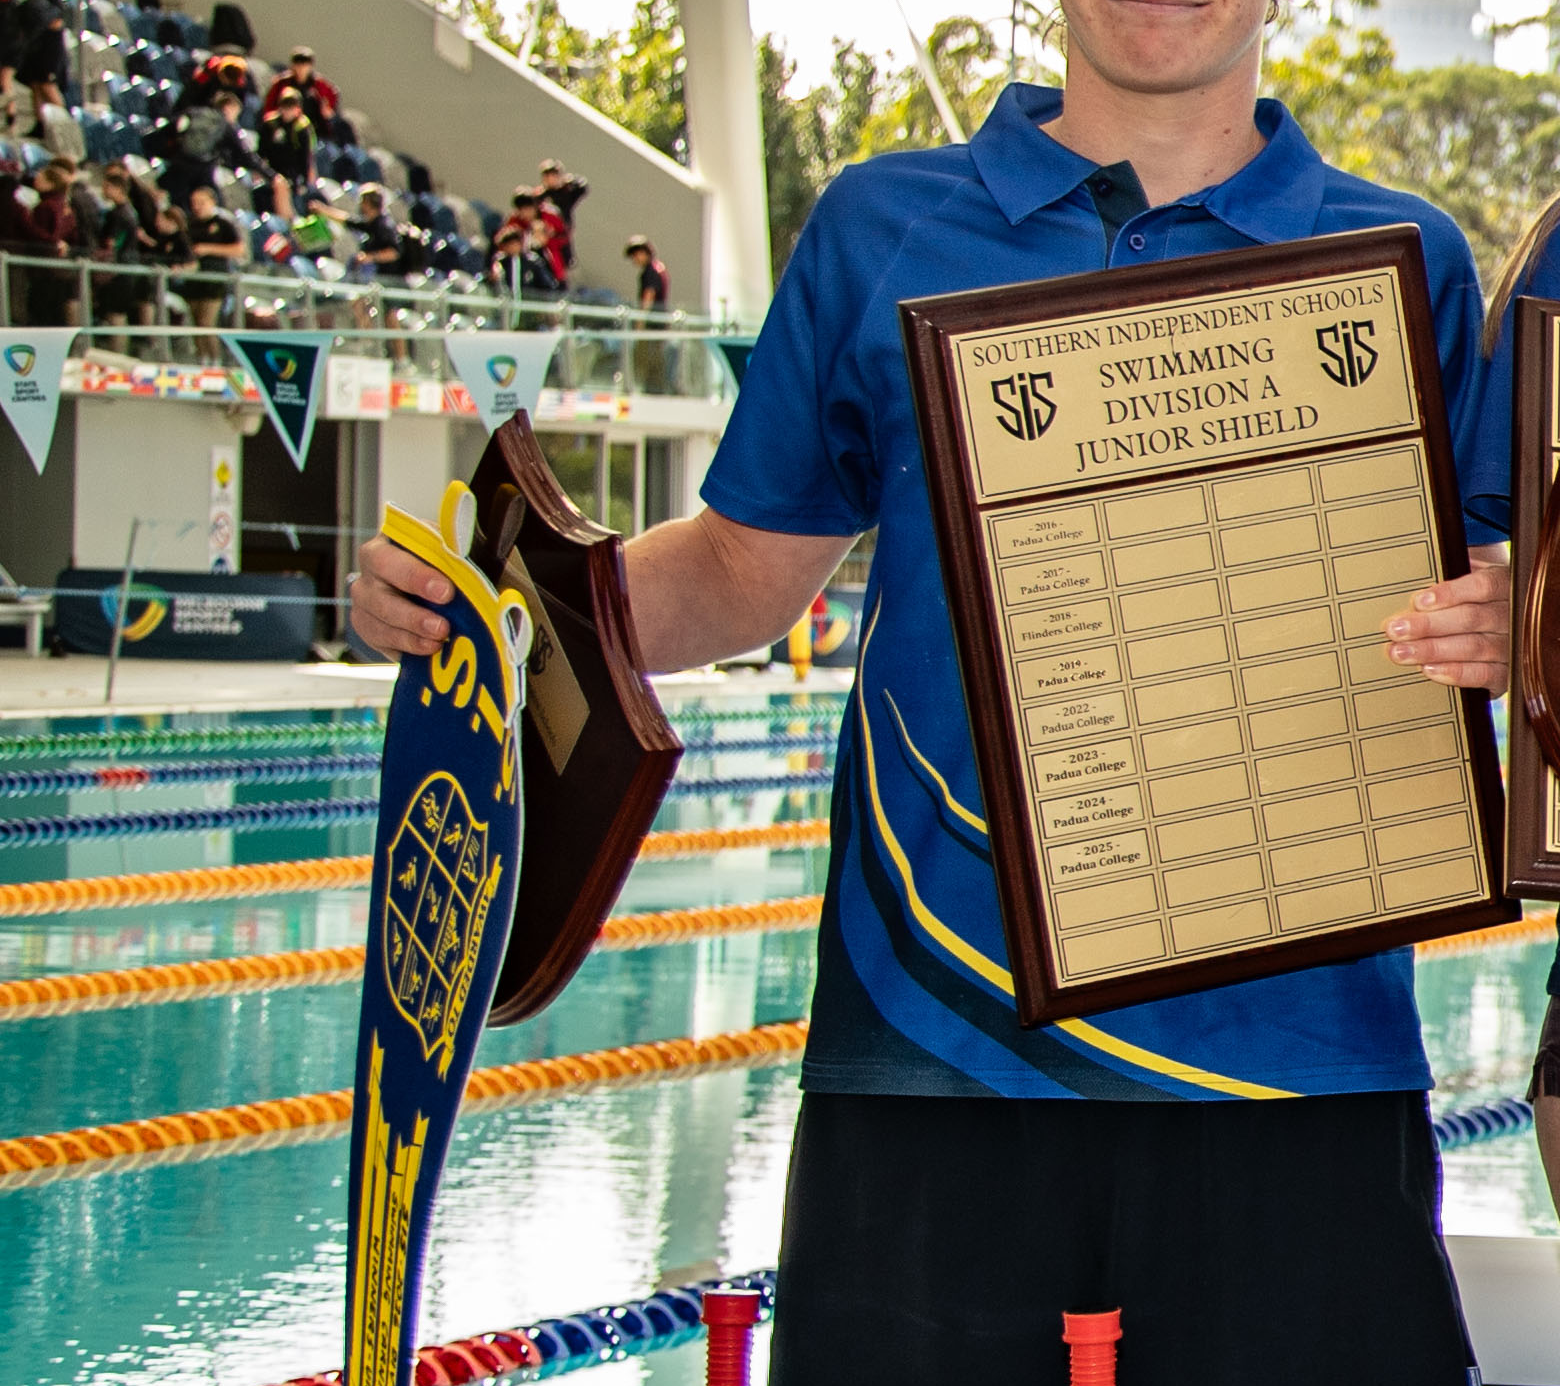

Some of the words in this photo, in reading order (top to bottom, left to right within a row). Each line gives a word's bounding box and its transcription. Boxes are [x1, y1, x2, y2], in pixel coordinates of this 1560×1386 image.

[973, 328, 1101, 367] SOUTHERN
[1109, 301, 1273, 347] INDEPENDENT
[1281, 283, 1384, 318] SCHOOLS
[1100, 337, 1275, 389] SWIMMING
[1104, 378, 1249, 426] DIVISION
[1260, 375, 1281, 399] A
[1075, 425, 1192, 472] JUNIOR
[1201, 404, 1319, 447] SHIELD
[1035, 521, 1057, 532] 2016
[1012, 536, 1043, 548] Padua
[1046, 529, 1083, 542] College
[1042, 568, 1064, 579] 2017
[1020, 583, 1051, 595] Padua
[1053, 576, 1090, 589] College
[1049, 612, 1071, 623] 2018
[1021, 628, 1063, 642] Flinders
[1065, 620, 1103, 633] College
[1059, 660, 1081, 672] 2019
[1038, 676, 1069, 688] Padua
[1071, 669, 1106, 682] College
[1062, 703, 1090, 717] 2022
[1041, 721, 1074, 735] Padua
[1076, 713, 1115, 728] College
[1069, 750, 1098, 763] 2023
[1046, 768, 1082, 782] Padua
[1085, 760, 1127, 775] College
[1076, 796, 1106, 810] 2024
[1053, 815, 1089, 829] Padua
[1092, 806, 1134, 821] College
[1060, 861, 1096, 875] Padua
[1099, 851, 1141, 867] College
